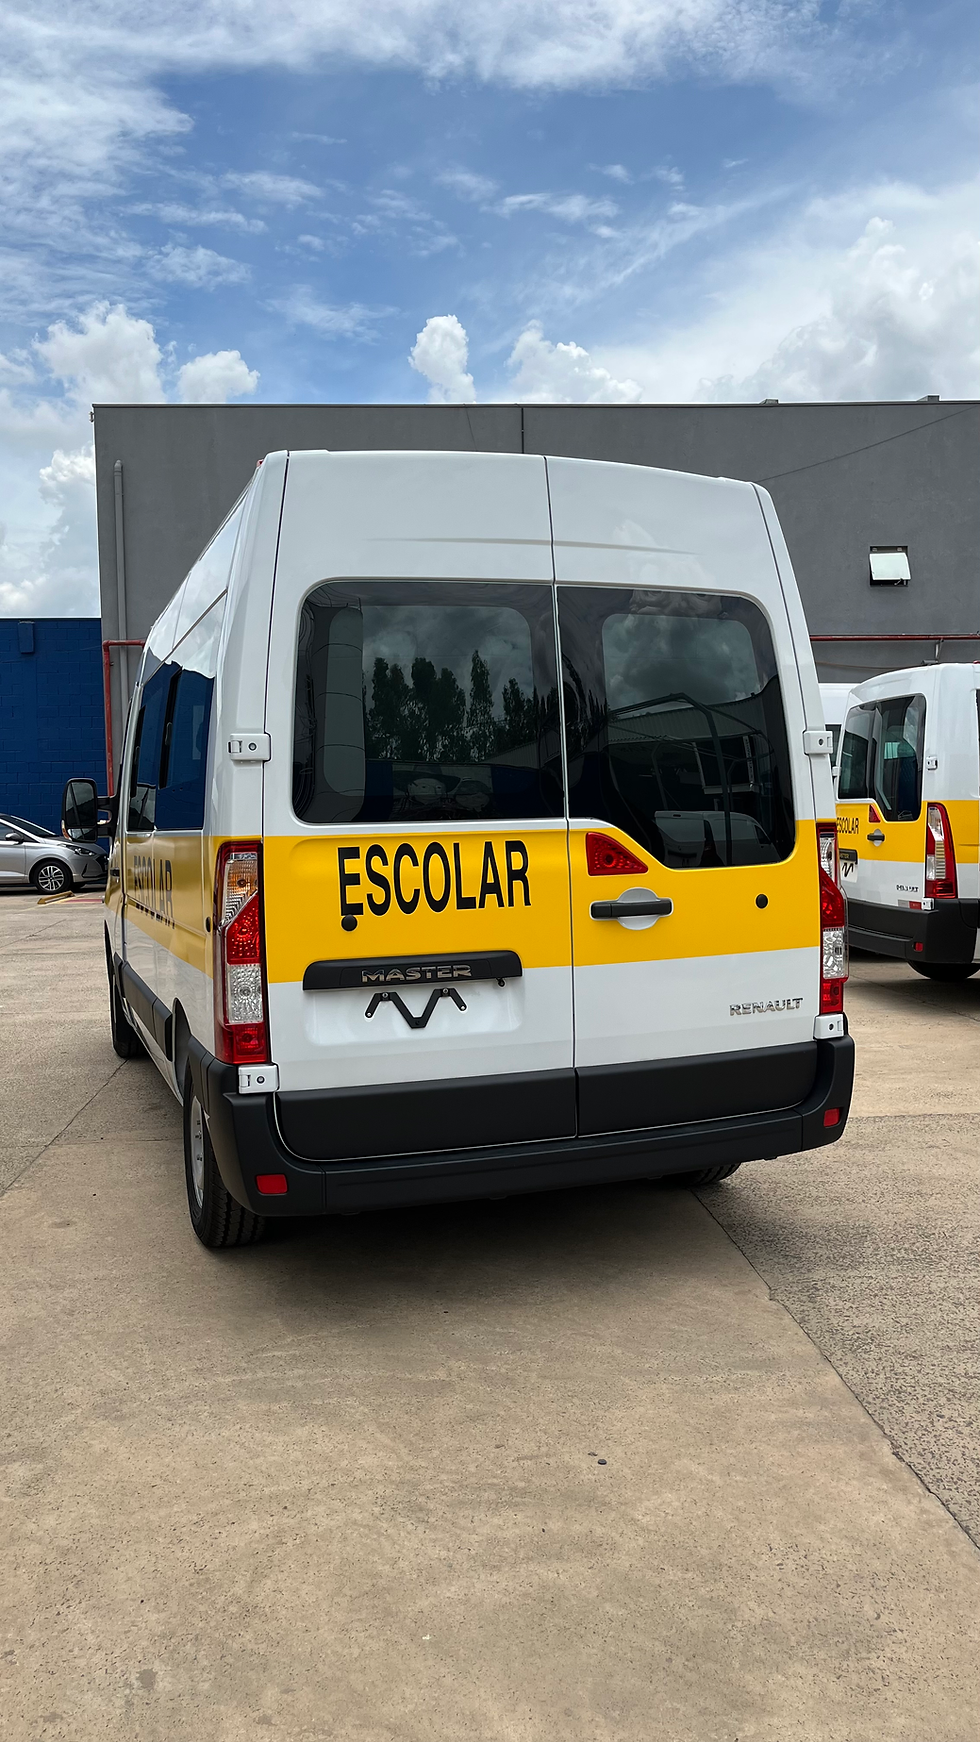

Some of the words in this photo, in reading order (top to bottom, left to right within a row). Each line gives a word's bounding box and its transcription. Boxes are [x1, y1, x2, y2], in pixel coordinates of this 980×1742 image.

[337, 840, 532, 917] ESCOLAR
[361, 964, 472, 983] MASTER
[729, 998, 803, 1016] RENAULT
